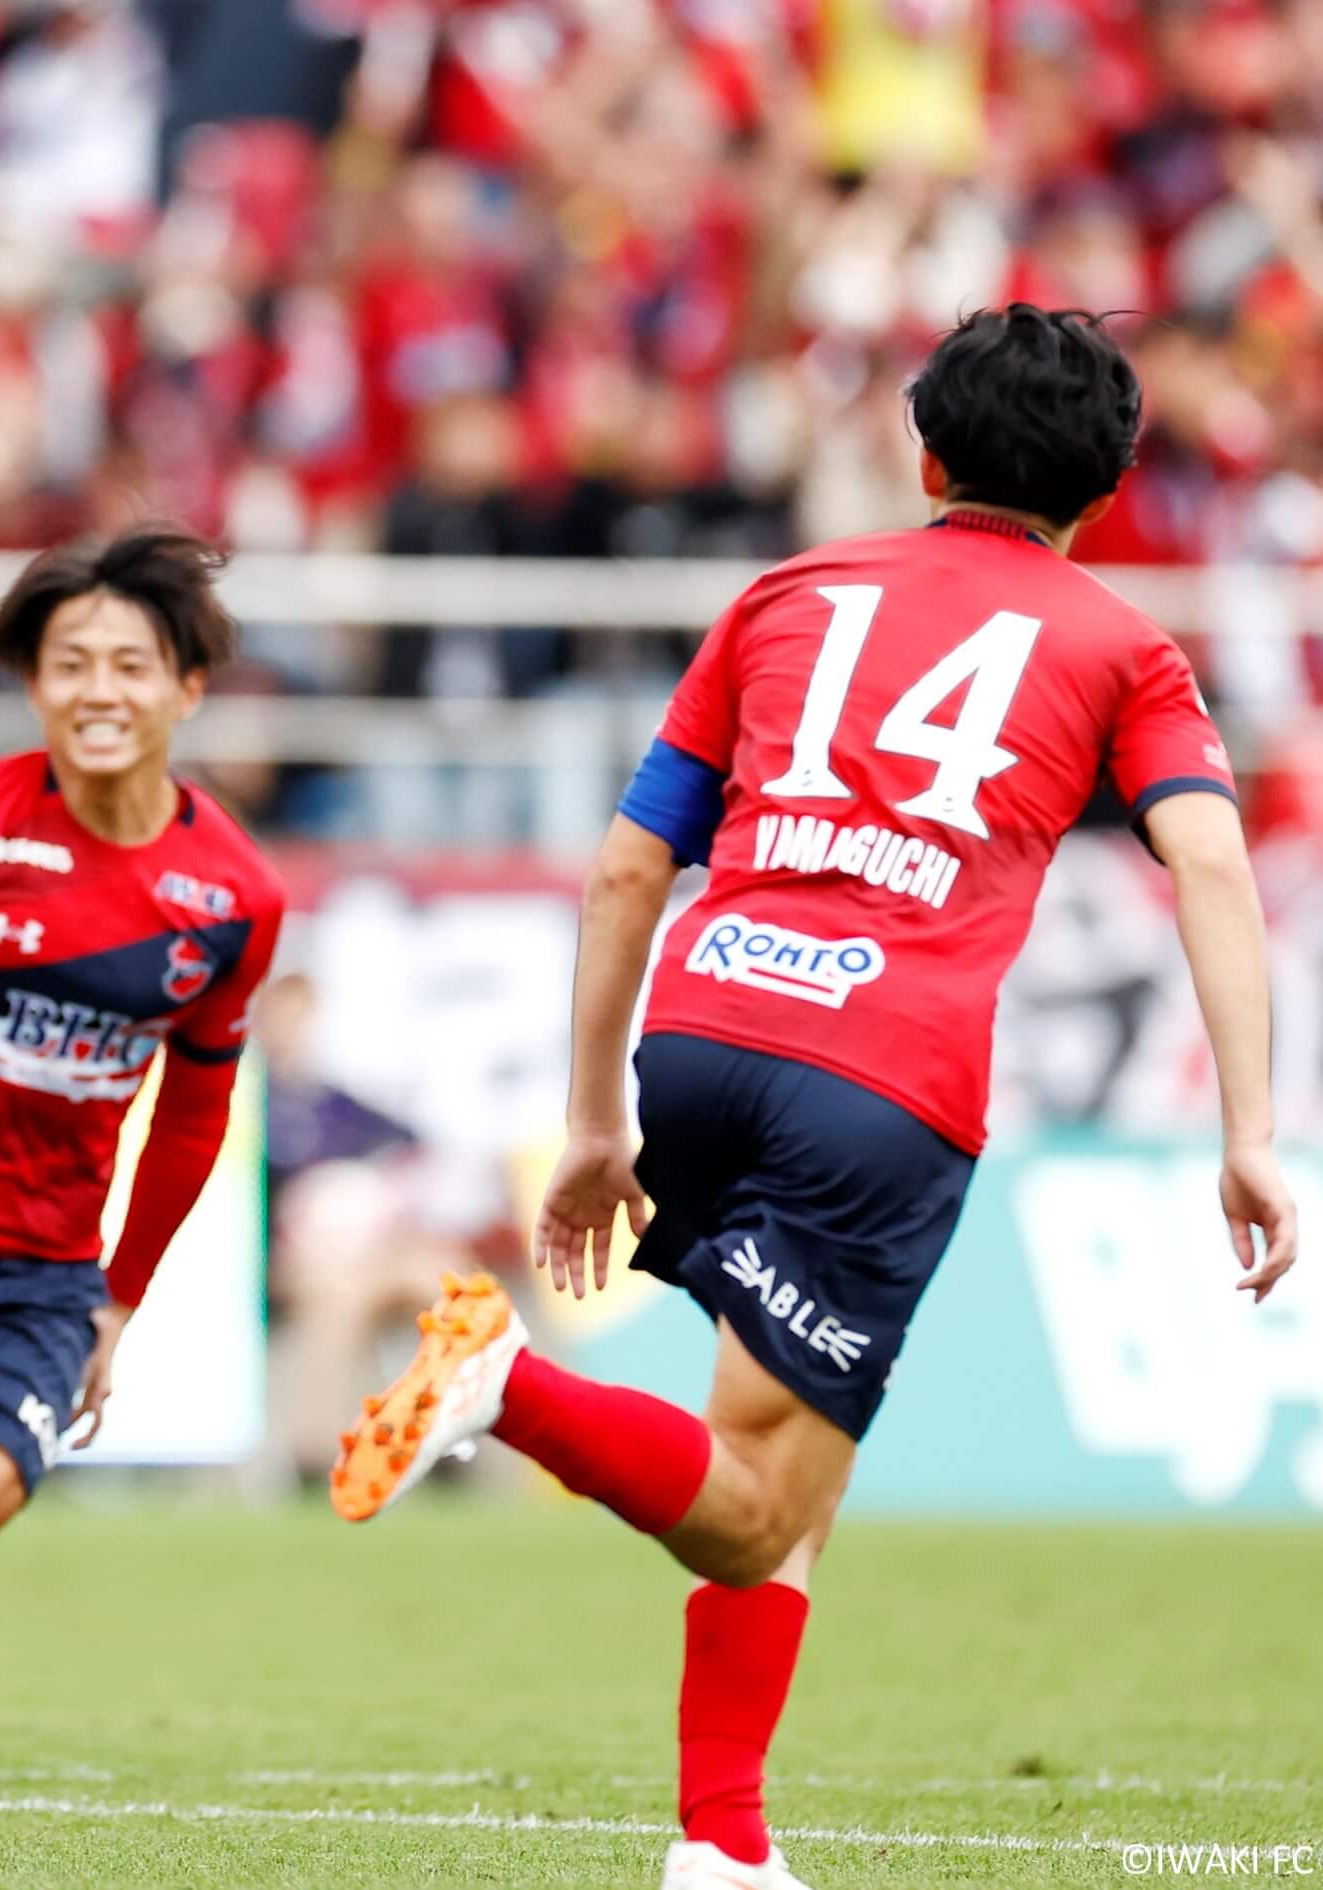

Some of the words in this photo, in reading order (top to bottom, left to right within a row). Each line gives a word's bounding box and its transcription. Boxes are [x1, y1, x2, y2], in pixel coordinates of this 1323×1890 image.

[760, 584, 1043, 840] 14
[752, 814, 961, 910] YAMAGUCHI
[698, 924, 872, 973] ROHTO
[721, 1237, 871, 1373] ABLE
